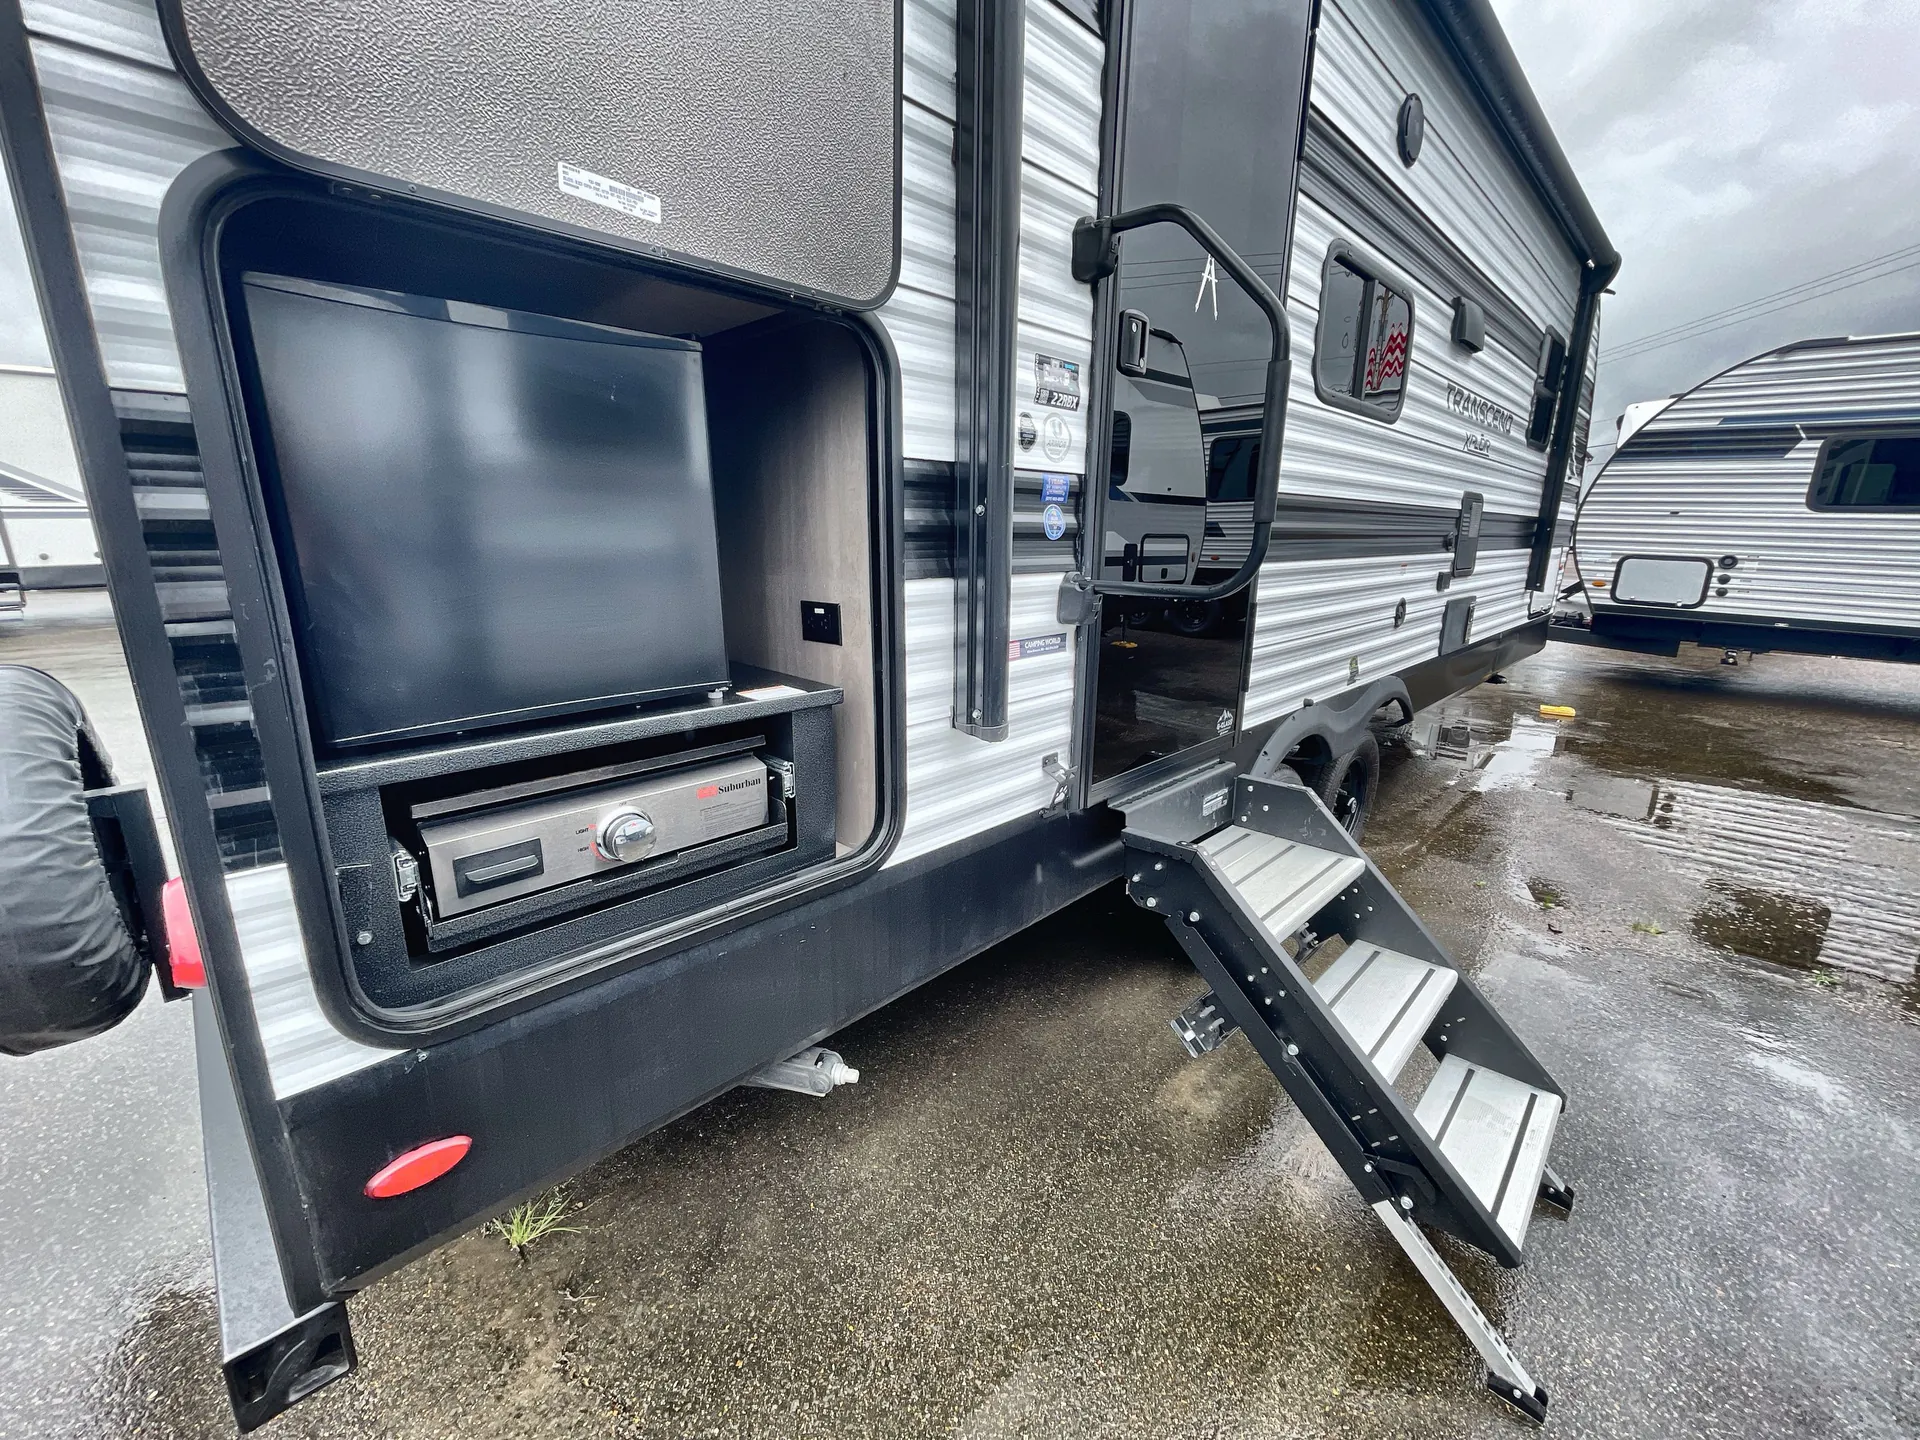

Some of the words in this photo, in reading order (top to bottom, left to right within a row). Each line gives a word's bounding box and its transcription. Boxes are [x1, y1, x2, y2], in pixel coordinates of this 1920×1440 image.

[1447, 382, 1514, 435] TRANSCEND
[1024, 639, 1045, 649] CAMPING
[718, 777, 761, 794] Suburban
[575, 827, 589, 835] LIGHT
